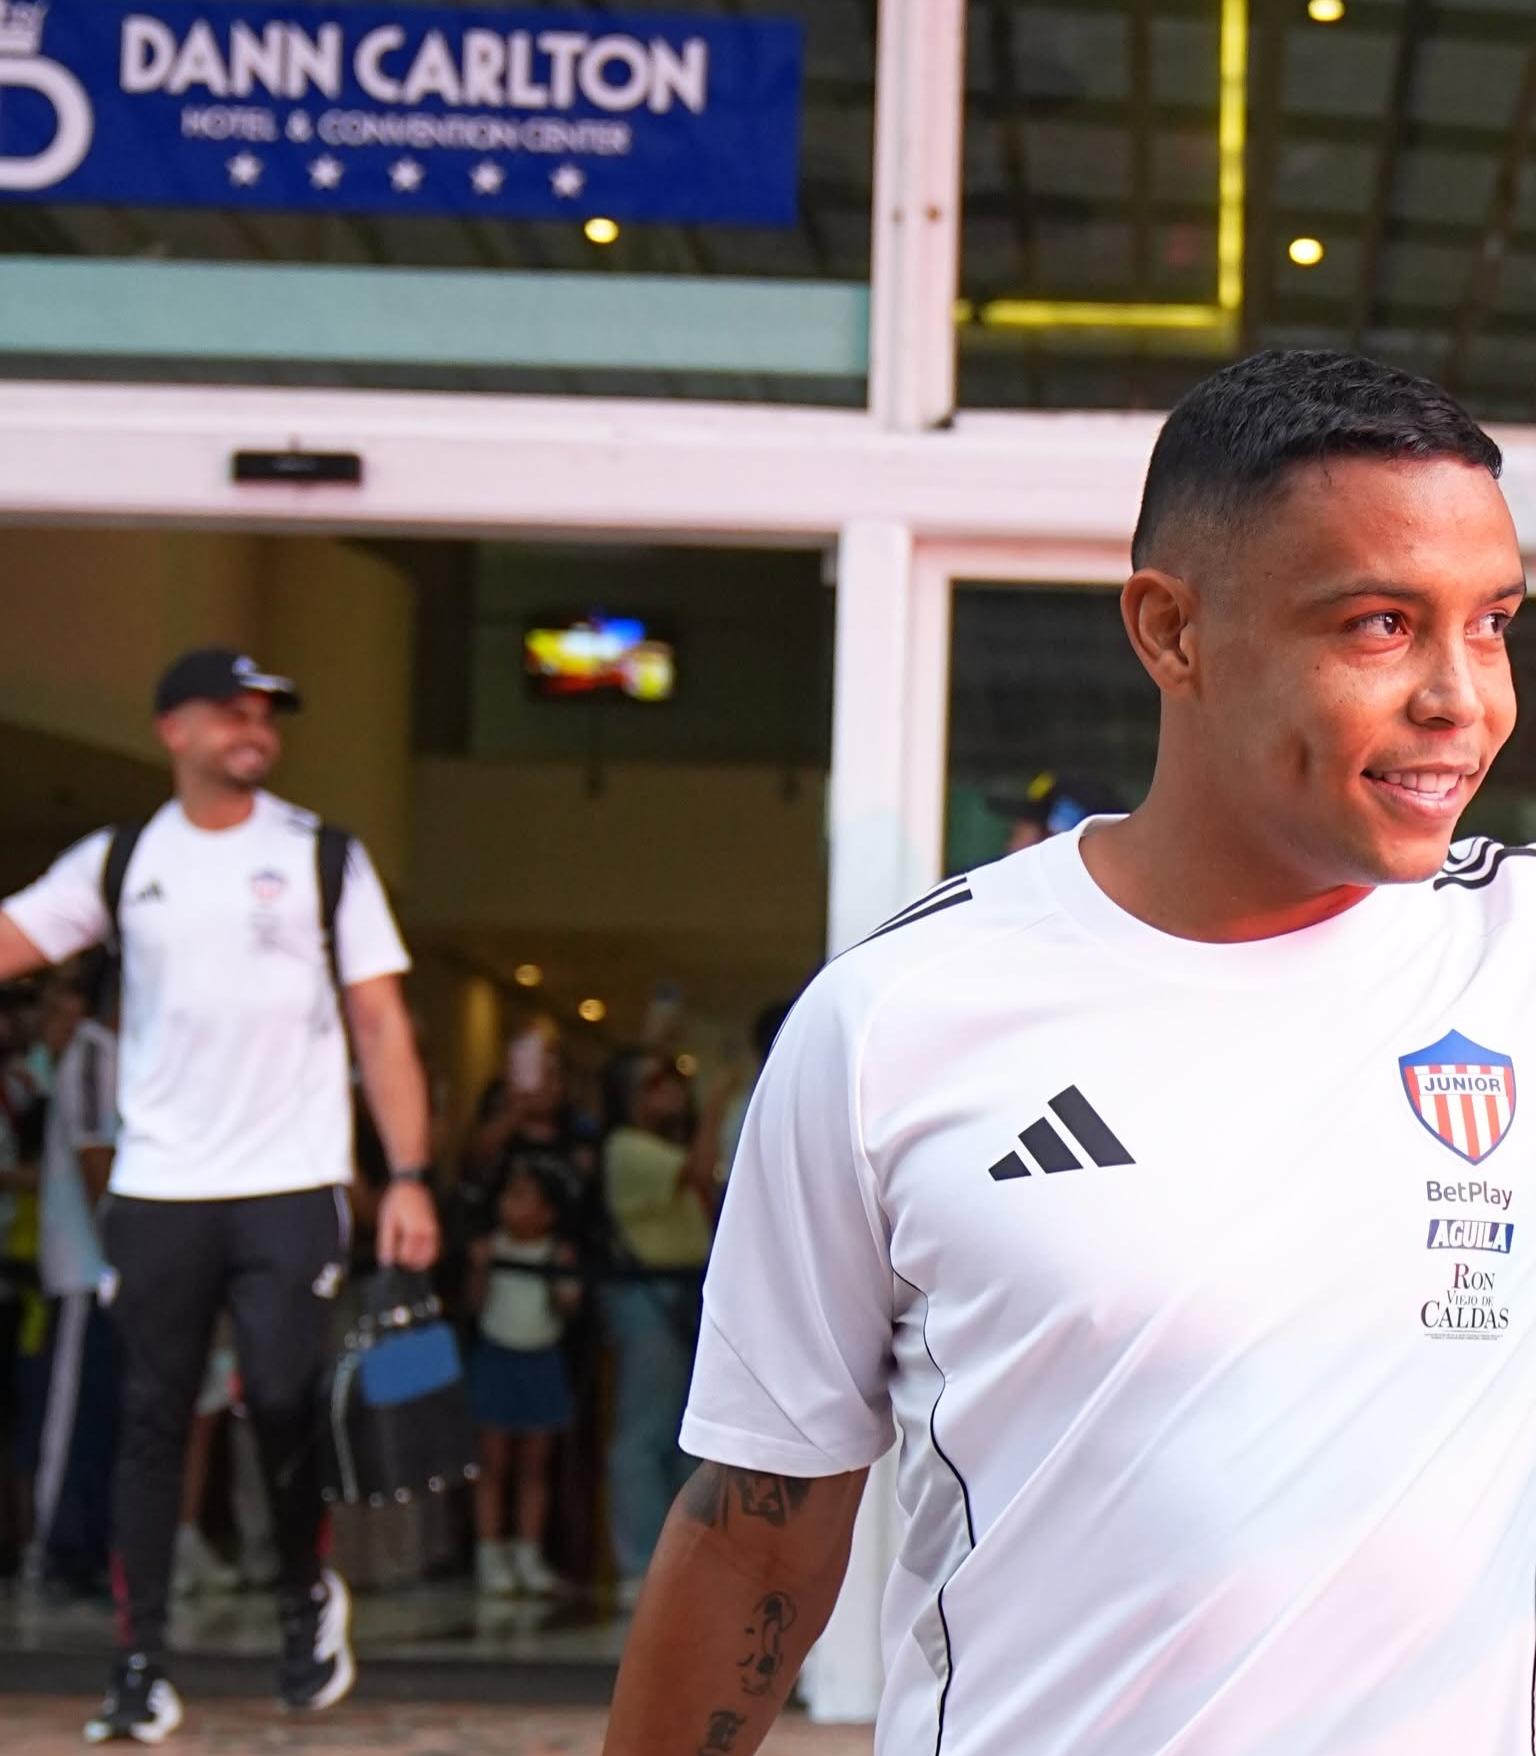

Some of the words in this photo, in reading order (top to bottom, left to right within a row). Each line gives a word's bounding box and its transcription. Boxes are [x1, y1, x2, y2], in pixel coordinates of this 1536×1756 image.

[119, 13, 344, 101] DANN
[353, 23, 708, 116] CARLTON
[180, 104, 278, 142] HOTEL
[285, 107, 313, 143] &
[316, 108, 518, 152] CONVENTION
[519, 115, 633, 156] CENTER
[1424, 1077, 1502, 1092] JUNIOR
[1426, 1180, 1513, 1210] BetPlay
[1429, 1219, 1510, 1252] AGUILA
[1420, 1299, 1509, 1329] CALDAS
